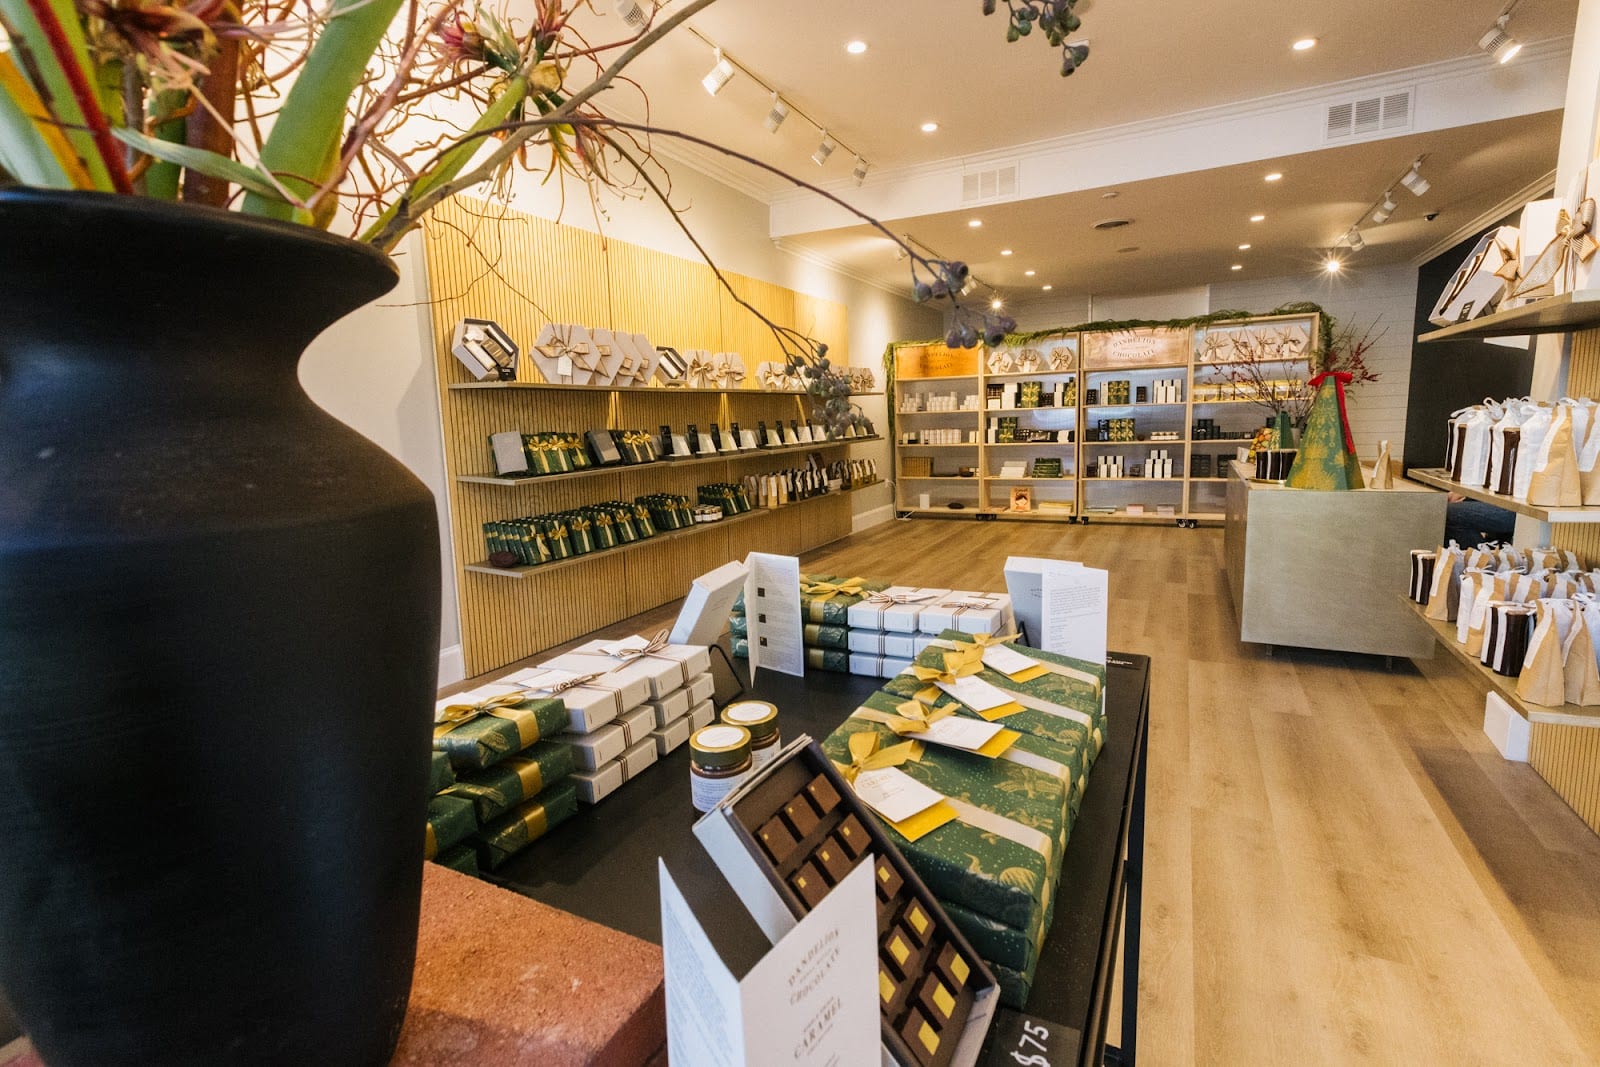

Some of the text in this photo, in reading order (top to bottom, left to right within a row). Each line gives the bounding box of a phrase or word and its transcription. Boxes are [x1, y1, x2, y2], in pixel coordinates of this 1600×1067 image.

[1112, 337, 1156, 348] DANDELION
[1112, 350, 1155, 359] CHOCOLATE
[788, 928, 839, 987] DANDELION
[789, 947, 840, 1007] CHOCOLATE
[793, 996, 841, 1060] CARAMEL
[1009, 1020, 1051, 1067] $75
